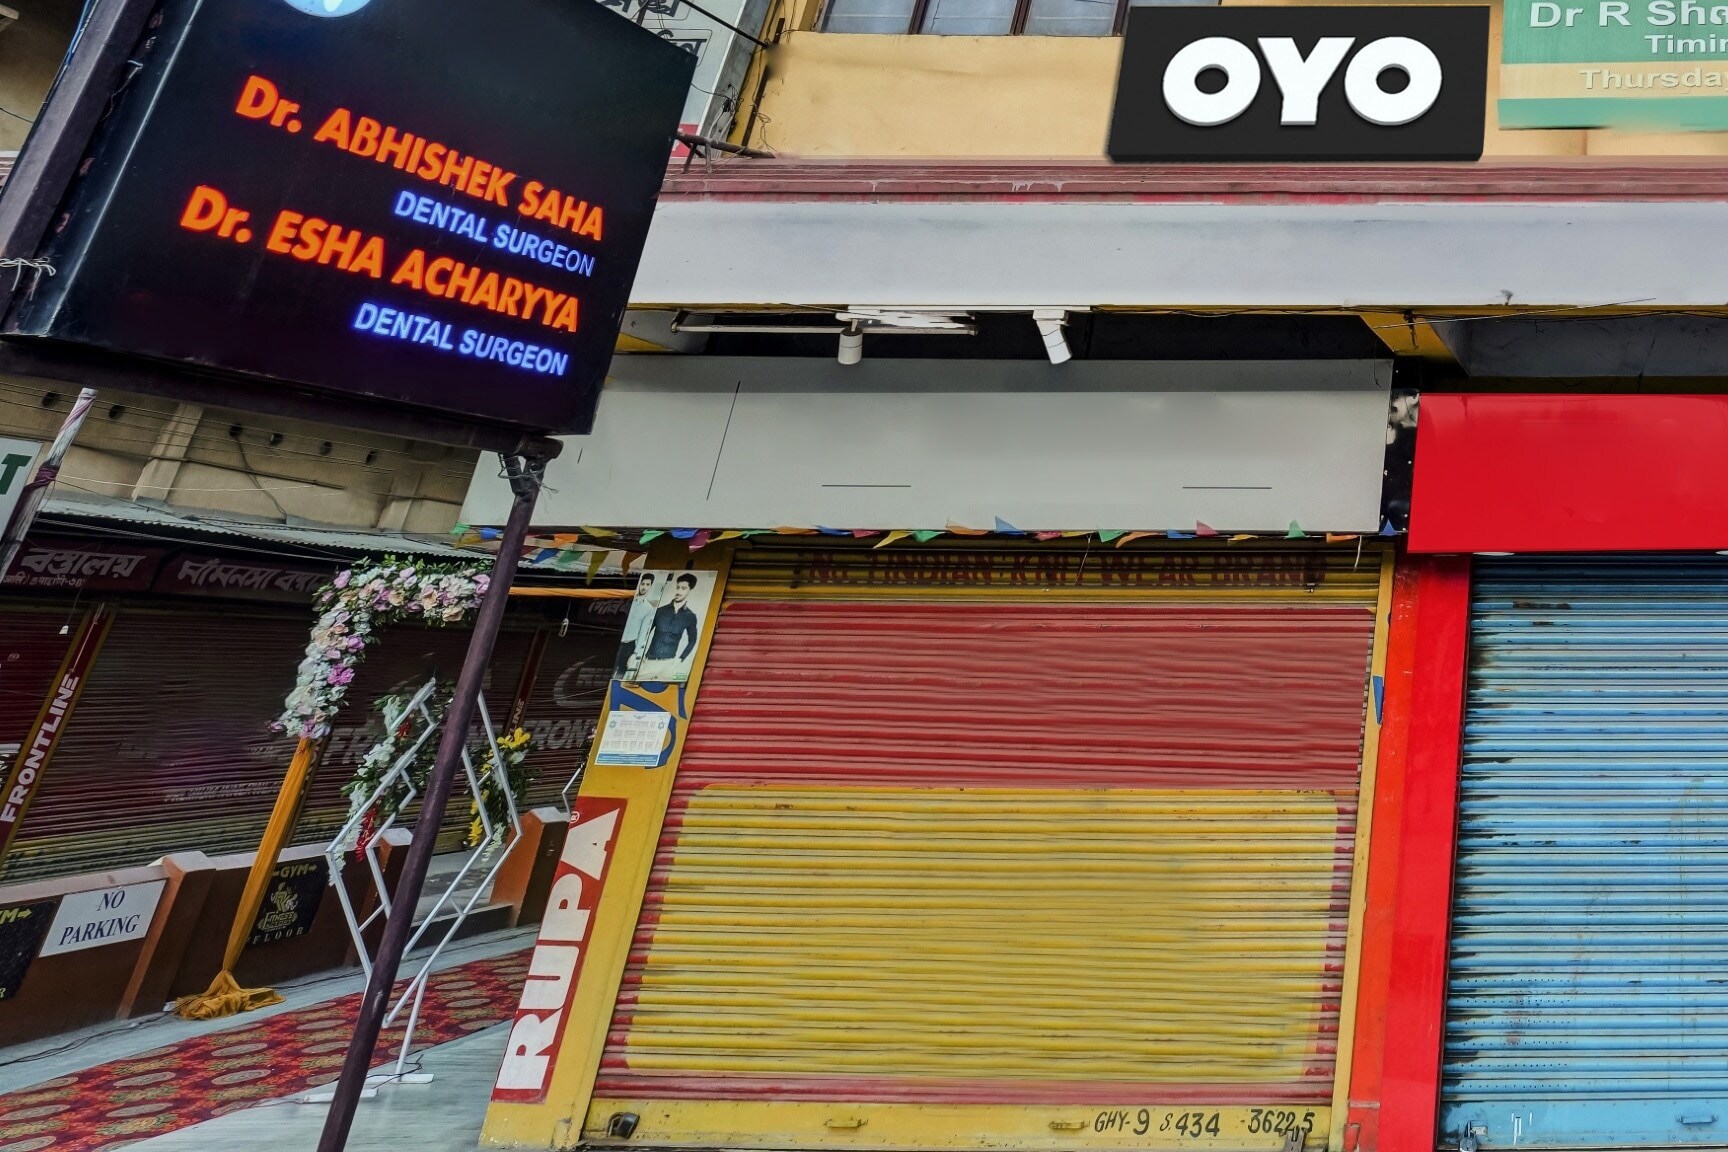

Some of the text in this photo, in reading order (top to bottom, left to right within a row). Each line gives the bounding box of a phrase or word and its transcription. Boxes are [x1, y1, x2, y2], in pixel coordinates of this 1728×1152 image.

[1530, 2, 1585, 28] Dr
[1599, 1, 1632, 26] R
[1162, 36, 1442, 126] OYO
[234, 73, 605, 242] Dr. ABHISHEK SAHA
[180, 185, 581, 333] Dr. ESHA ACHARYYA
[394, 190, 595, 278] DENTAL SURGEON
[354, 302, 569, 377] DENTAL SURGEON
[1, 673, 79, 823] FRONTLINE
[97, 890, 126, 911] NO
[280, 864, 309, 878] GYM
[58, 914, 141, 946] PARKING
[253, 927, 304, 944] FLOOR
[495, 808, 621, 1091] RUPA
